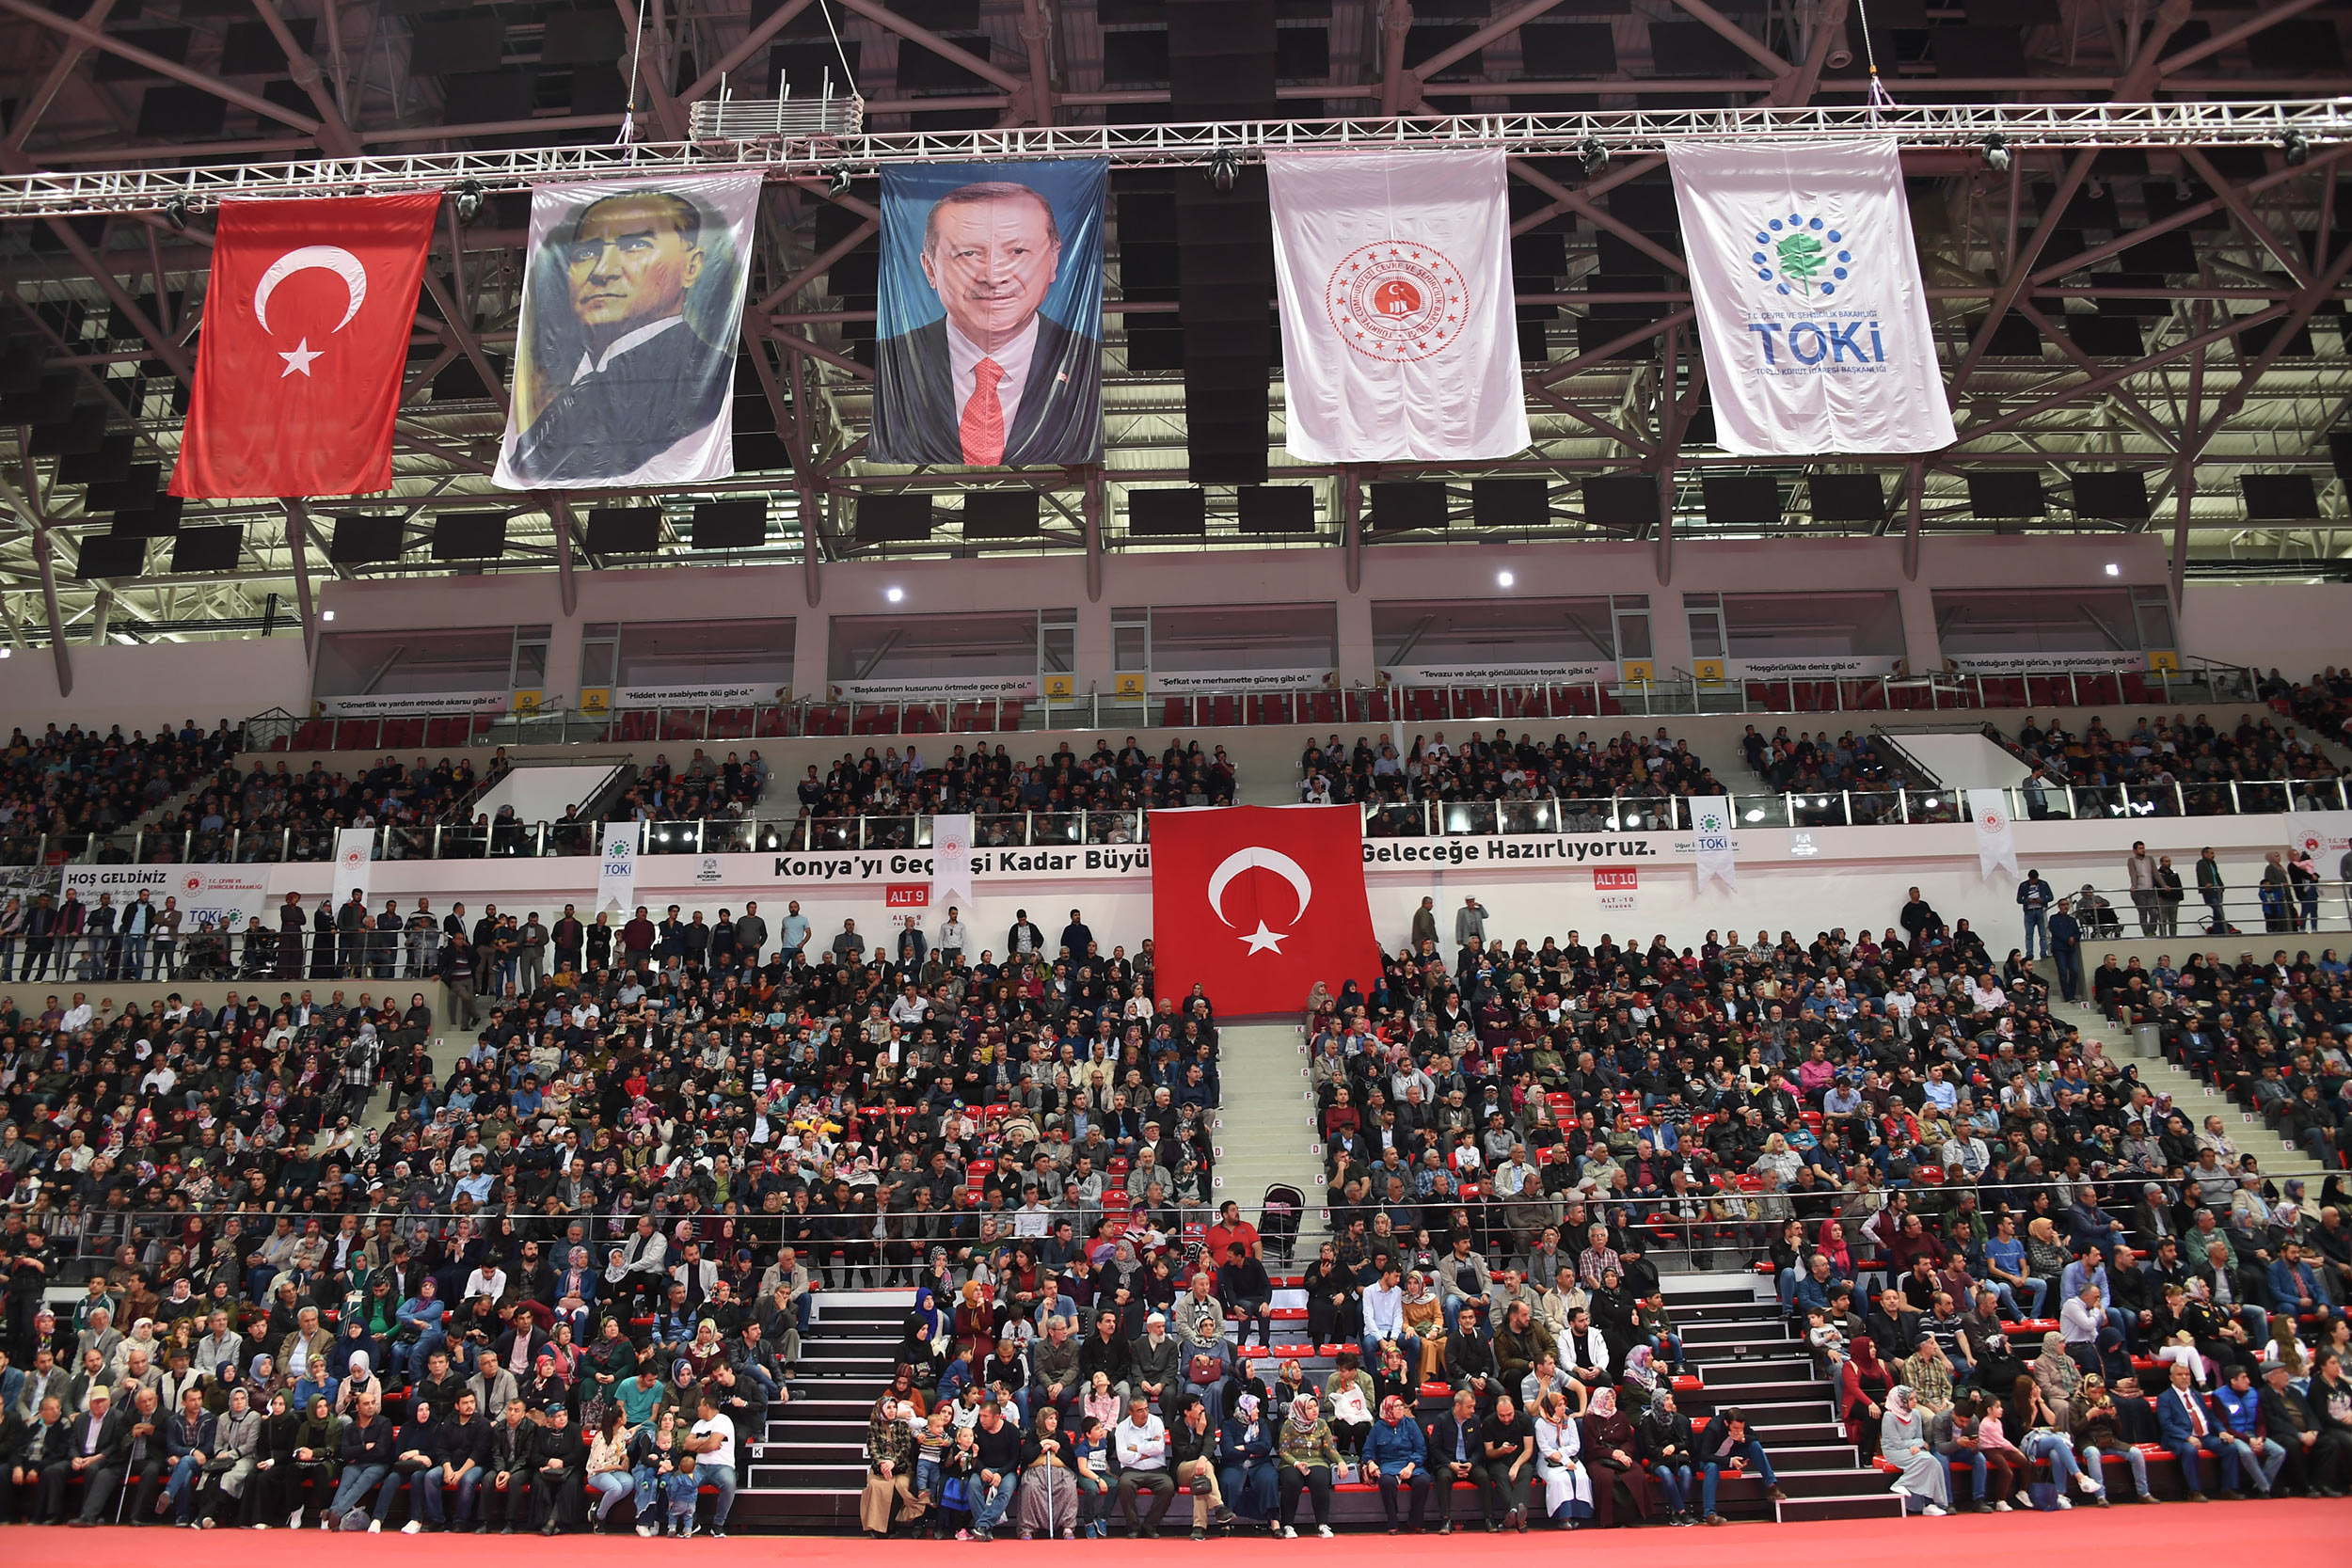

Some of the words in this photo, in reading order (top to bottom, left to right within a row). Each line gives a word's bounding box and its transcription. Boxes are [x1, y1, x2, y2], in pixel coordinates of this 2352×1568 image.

[1375, 261, 1403, 274] ÇEVRE
[1406, 262, 1417, 273] VE
[1417, 267, 1443, 306] ŞEHİRCİLİK
[1353, 269, 1375, 317] CUMHURİYETİ
[1407, 306, 1442, 339] BAKANLIĞI
[1360, 317, 1393, 340] TÜRKİYE
[2010, 659, 2026, 668] gibi
[2063, 657, 2111, 667] göründüğün
[2112, 657, 2127, 666] gibi
[1466, 670, 1487, 678] alçak
[1488, 669, 1539, 677] gönüllülükte
[1540, 668, 1567, 676] toprak
[1280, 675, 1296, 684] gibi
[1001, 682, 1016, 690] gibi
[668, 690, 709, 699] asabiyette
[1362, 841, 1480, 864] Geleceğe
[1487, 839, 1656, 863] Hazırlıyoruz.
[1000, 852, 1077, 871] Kadar
[68, 873, 97, 886] HOŞ
[103, 869, 167, 884] GELDİNİZ
[1596, 873, 1617, 885] ALT
[1619, 873, 1635, 885] 10
[890, 890, 914, 902] ALT
[915, 890, 924, 902] 9
[1215, 1119, 1220, 1128] E
[1312, 1145, 1319, 1153] D
[2285, 1141, 2292, 1149] C
[1215, 1148, 1220, 1156] D
[1215, 1178, 1220, 1186] C
[1316, 1175, 1323, 1183] C
[1215, 1212, 1221, 1220] B
[1322, 1210, 1328, 1218] B
